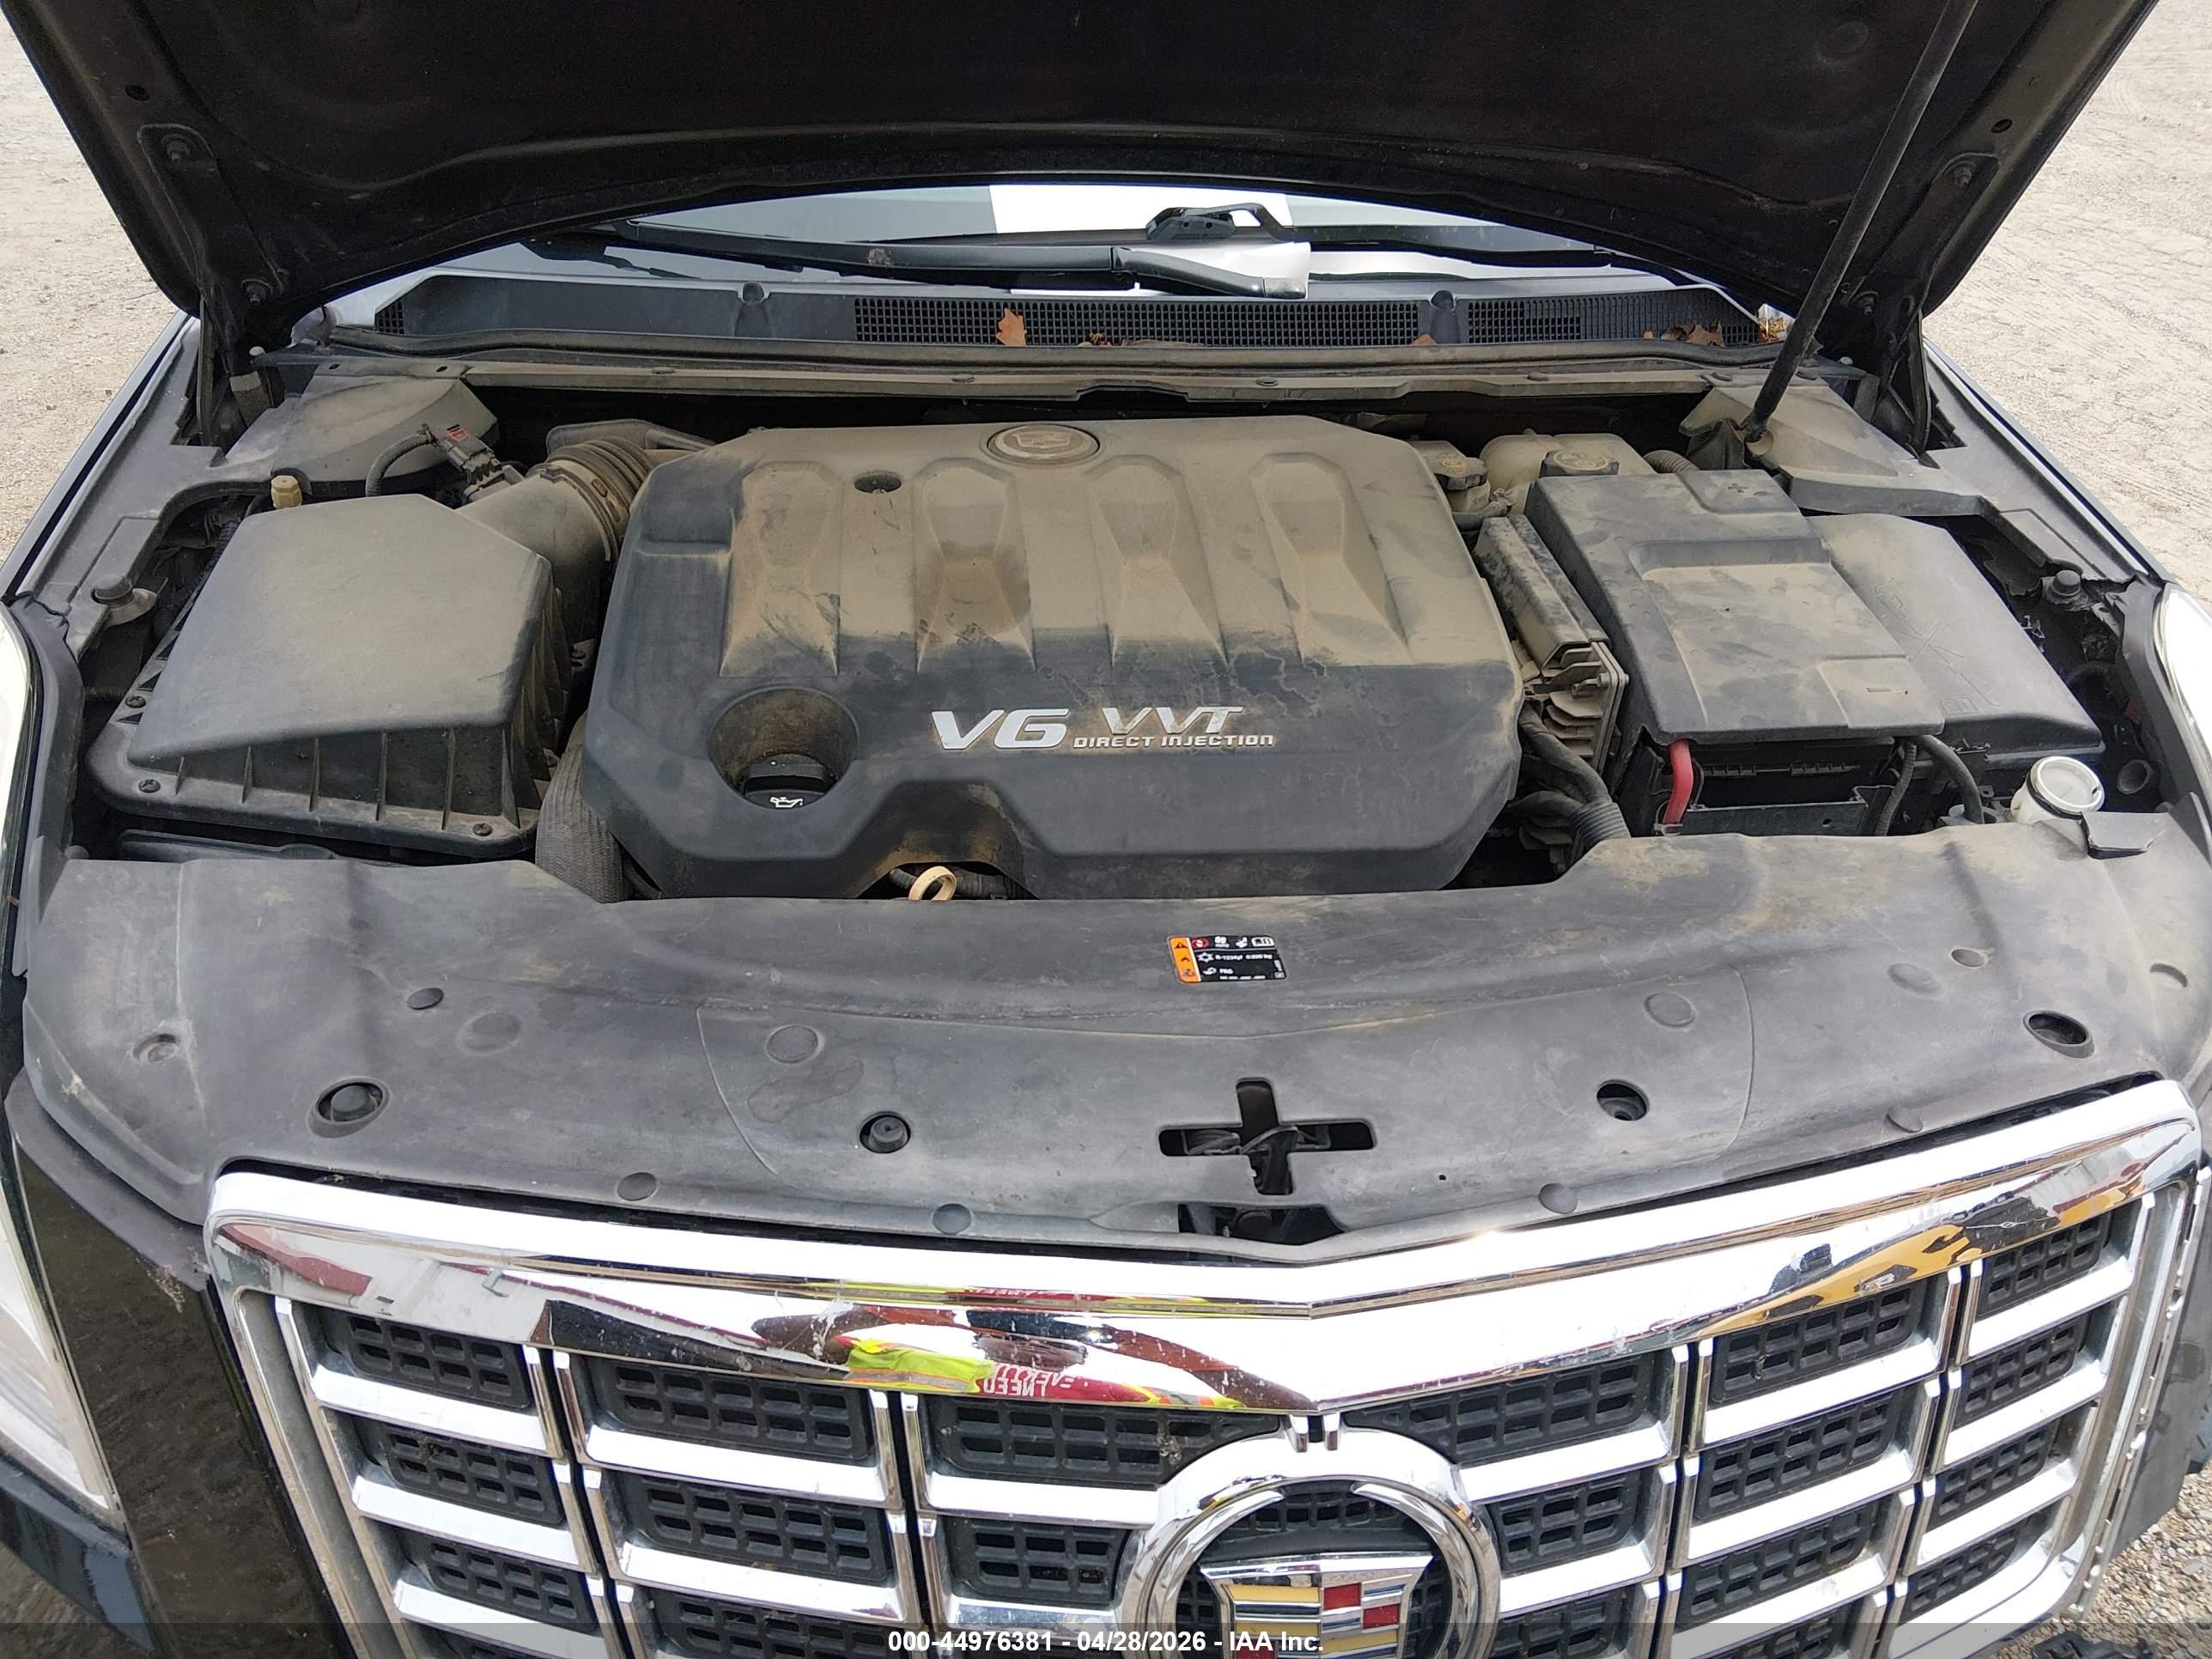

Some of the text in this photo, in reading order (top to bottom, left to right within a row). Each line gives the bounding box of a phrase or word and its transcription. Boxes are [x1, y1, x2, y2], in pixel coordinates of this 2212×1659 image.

[931, 706, 1244, 750] V6 VVT
[1073, 734, 1274, 748] DIRECT INJECTION
